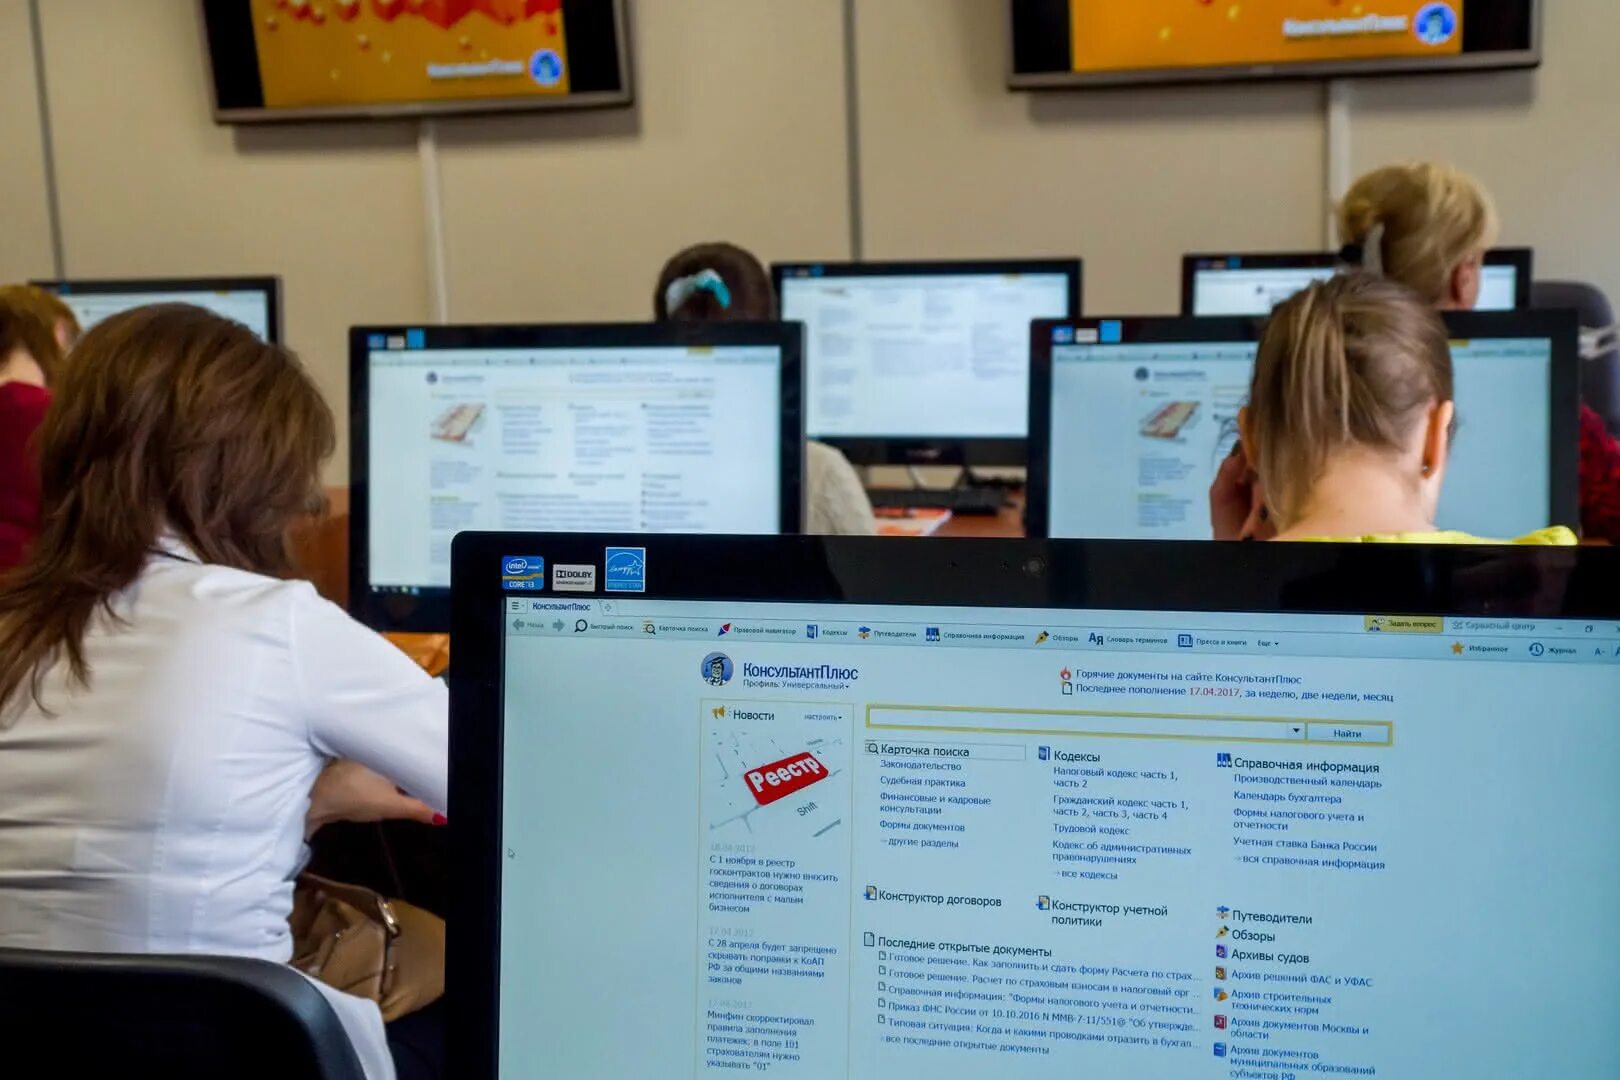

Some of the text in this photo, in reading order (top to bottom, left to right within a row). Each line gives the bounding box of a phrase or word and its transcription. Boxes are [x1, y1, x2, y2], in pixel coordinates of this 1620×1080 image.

[533, 602, 591, 611] КонсультантПлюс
[659, 625, 686, 633] Карточка
[734, 626, 764, 634] Правовой
[822, 629, 848, 637] Кодексы
[874, 630, 916, 638] Путеводители
[943, 631, 1025, 642] Справочная информация
[1052, 634, 1078, 643] Обзоры
[1107, 636, 1134, 645] Словарь
[743, 662, 858, 680] КонсультантПлюс
[1076, 670, 1302, 685] Горячие документы на сайте КонсультантПлюс
[743, 680, 844, 691] Профиль: Универсальный
[1076, 684, 1126, 694] Последнее
[1128, 686, 1186, 696] пополнение
[1189, 687, 1242, 698] 17.04.2017,
[1259, 691, 1298, 700] неделю,
[1322, 693, 1360, 702] недели,
[1363, 694, 1393, 702] месяц
[733, 710, 774, 721] Новости
[1334, 730, 1361, 738] Найти
[881, 744, 969, 757] Карточка поиска
[1054, 750, 1100, 762] Кодексы
[881, 760, 961, 771] Законодательство
[1234, 758, 1379, 773] Справочная информация
[748, 757, 819, 792] Реестр
[1054, 767, 1104, 777] Налоговый
[1107, 770, 1138, 779] кодекс
[1170, 771, 1178, 781] 1,
[881, 776, 965, 788] Судебная практика
[1054, 779, 1088, 788] часть 2
[1234, 774, 1382, 789] Производственный календарь
[880, 792, 991, 806] Финансовые кадровые
[1054, 794, 1188, 810] Гражданский кодекс часть 1,
[1234, 791, 1342, 804] Календарь бухгалтера
[797, 801, 818, 816] Shift
[880, 805, 941, 815] консультации
[1053, 808, 1167, 820] часть 2, часть 3, часть 4
[1234, 808, 1354, 822] Формы налогового учета
[880, 820, 965, 832] Формы документов
[1054, 824, 1130, 835] Трудовой кодекс
[1234, 821, 1288, 831] отчетности
[888, 838, 958, 848] другие разделы
[1053, 840, 1191, 855] Кодекс об административных
[1234, 837, 1377, 852] Учетная ставка Банка России
[726, 856, 795, 868] ноября реестр
[1053, 854, 1136, 864] правонарушениях
[1243, 856, 1385, 870] вся справочная информация
[709, 869, 770, 878] госконтрактов
[1062, 870, 1118, 880] все кодексы
[759, 883, 803, 892] договорах
[709, 894, 803, 904] исполнителя малым
[879, 890, 1002, 907] Конструктор договоров
[709, 903, 749, 912] бизнесом
[1052, 900, 1168, 916] Конструктор учетной
[1052, 916, 1102, 927] политики
[1232, 910, 1312, 924] Путеводители
[1232, 929, 1275, 943] Обзоры
[729, 941, 759, 950] апреля
[762, 942, 785, 951] будет
[789, 945, 836, 954] запрещено
[878, 937, 1051, 958] Последние открытые документы
[708, 952, 824, 966] скрывать поправки КоАП
[1232, 949, 1309, 964] Архивы судов
[708, 962, 720, 971] РФ
[735, 965, 768, 974] общими
[772, 969, 824, 978] названиями
[708, 976, 742, 984] законов
[1232, 970, 1374, 987] Архив решений ФАС УФАС
[1232, 990, 1332, 1004] Архив строительных
[889, 1001, 920, 1013] Приказ
[923, 1005, 942, 1014] ФНС
[945, 1007, 976, 1016] России
[992, 1010, 1040, 1020] 10.10.2016
[1129, 1018, 1146, 1028] "Об
[1232, 1002, 1319, 1016] технических норм
[1231, 1017, 1360, 1034] Архив документов Москвы
[1231, 1029, 1269, 1040] области
[1230, 1045, 1319, 1059] Архив документов
[1230, 1058, 1375, 1075] муниципальных образований
